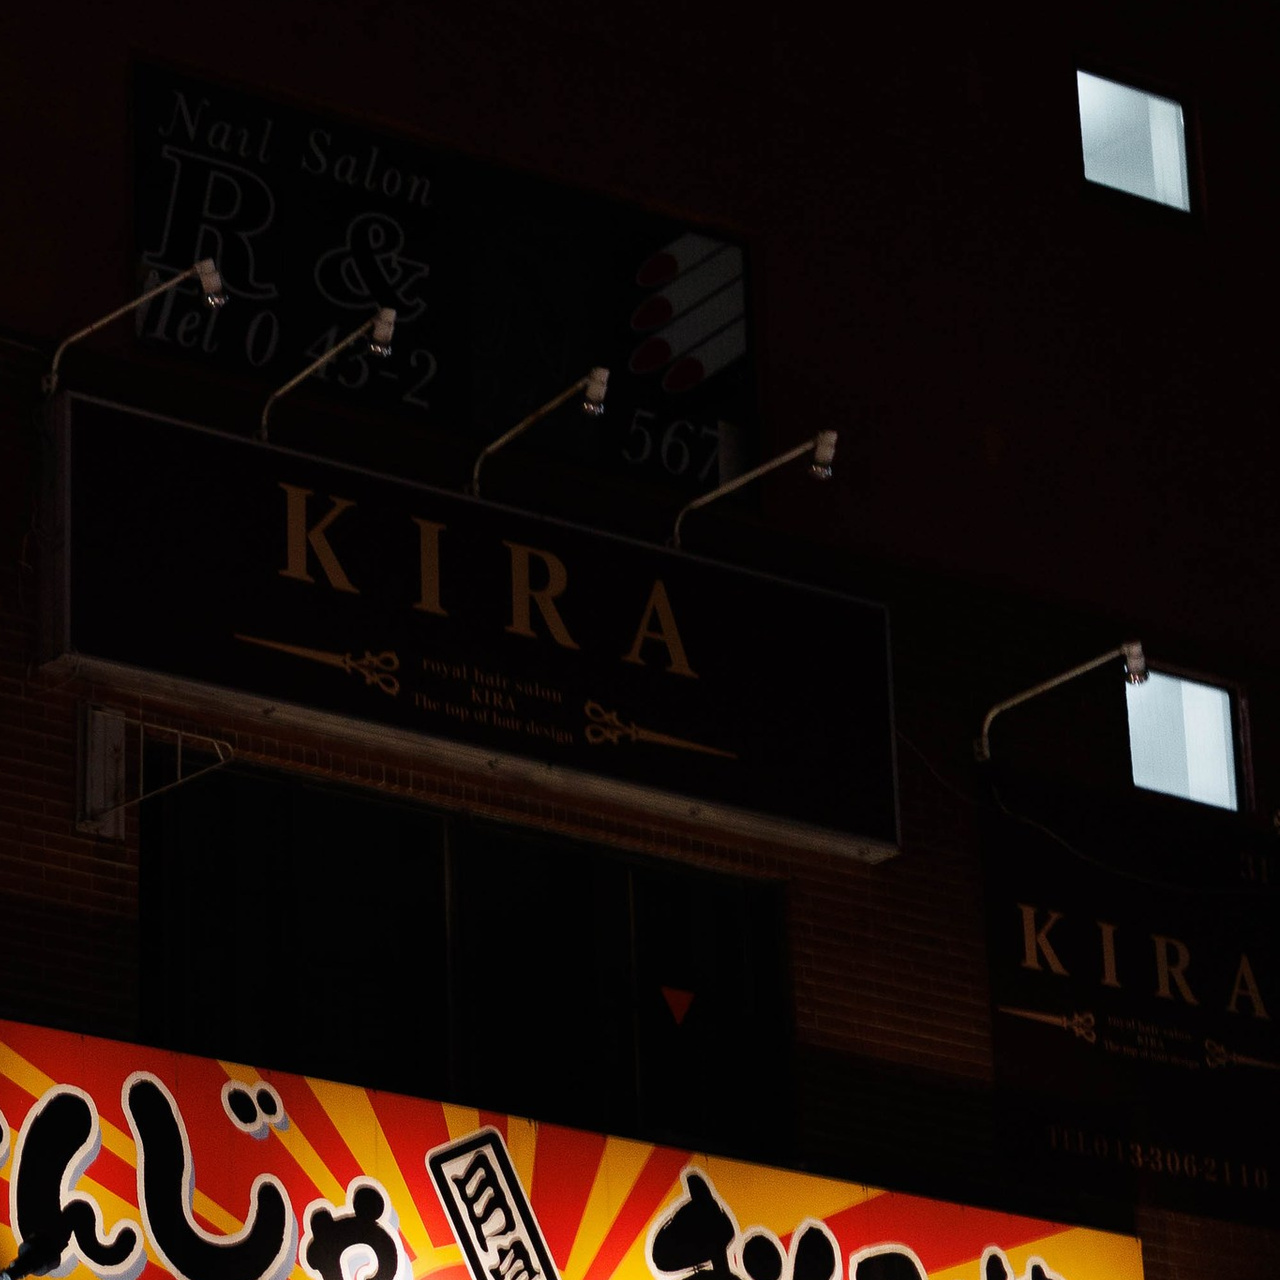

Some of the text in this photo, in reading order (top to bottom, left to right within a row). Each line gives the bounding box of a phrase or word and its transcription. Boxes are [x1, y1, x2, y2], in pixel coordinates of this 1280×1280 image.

[157, 91, 434, 210] Nail Salon
[141, 143, 279, 301] R
[277, 481, 700, 681] KIRA
[471, 686, 516, 712] KIRA
[1016, 901, 1274, 1021] KIRA
